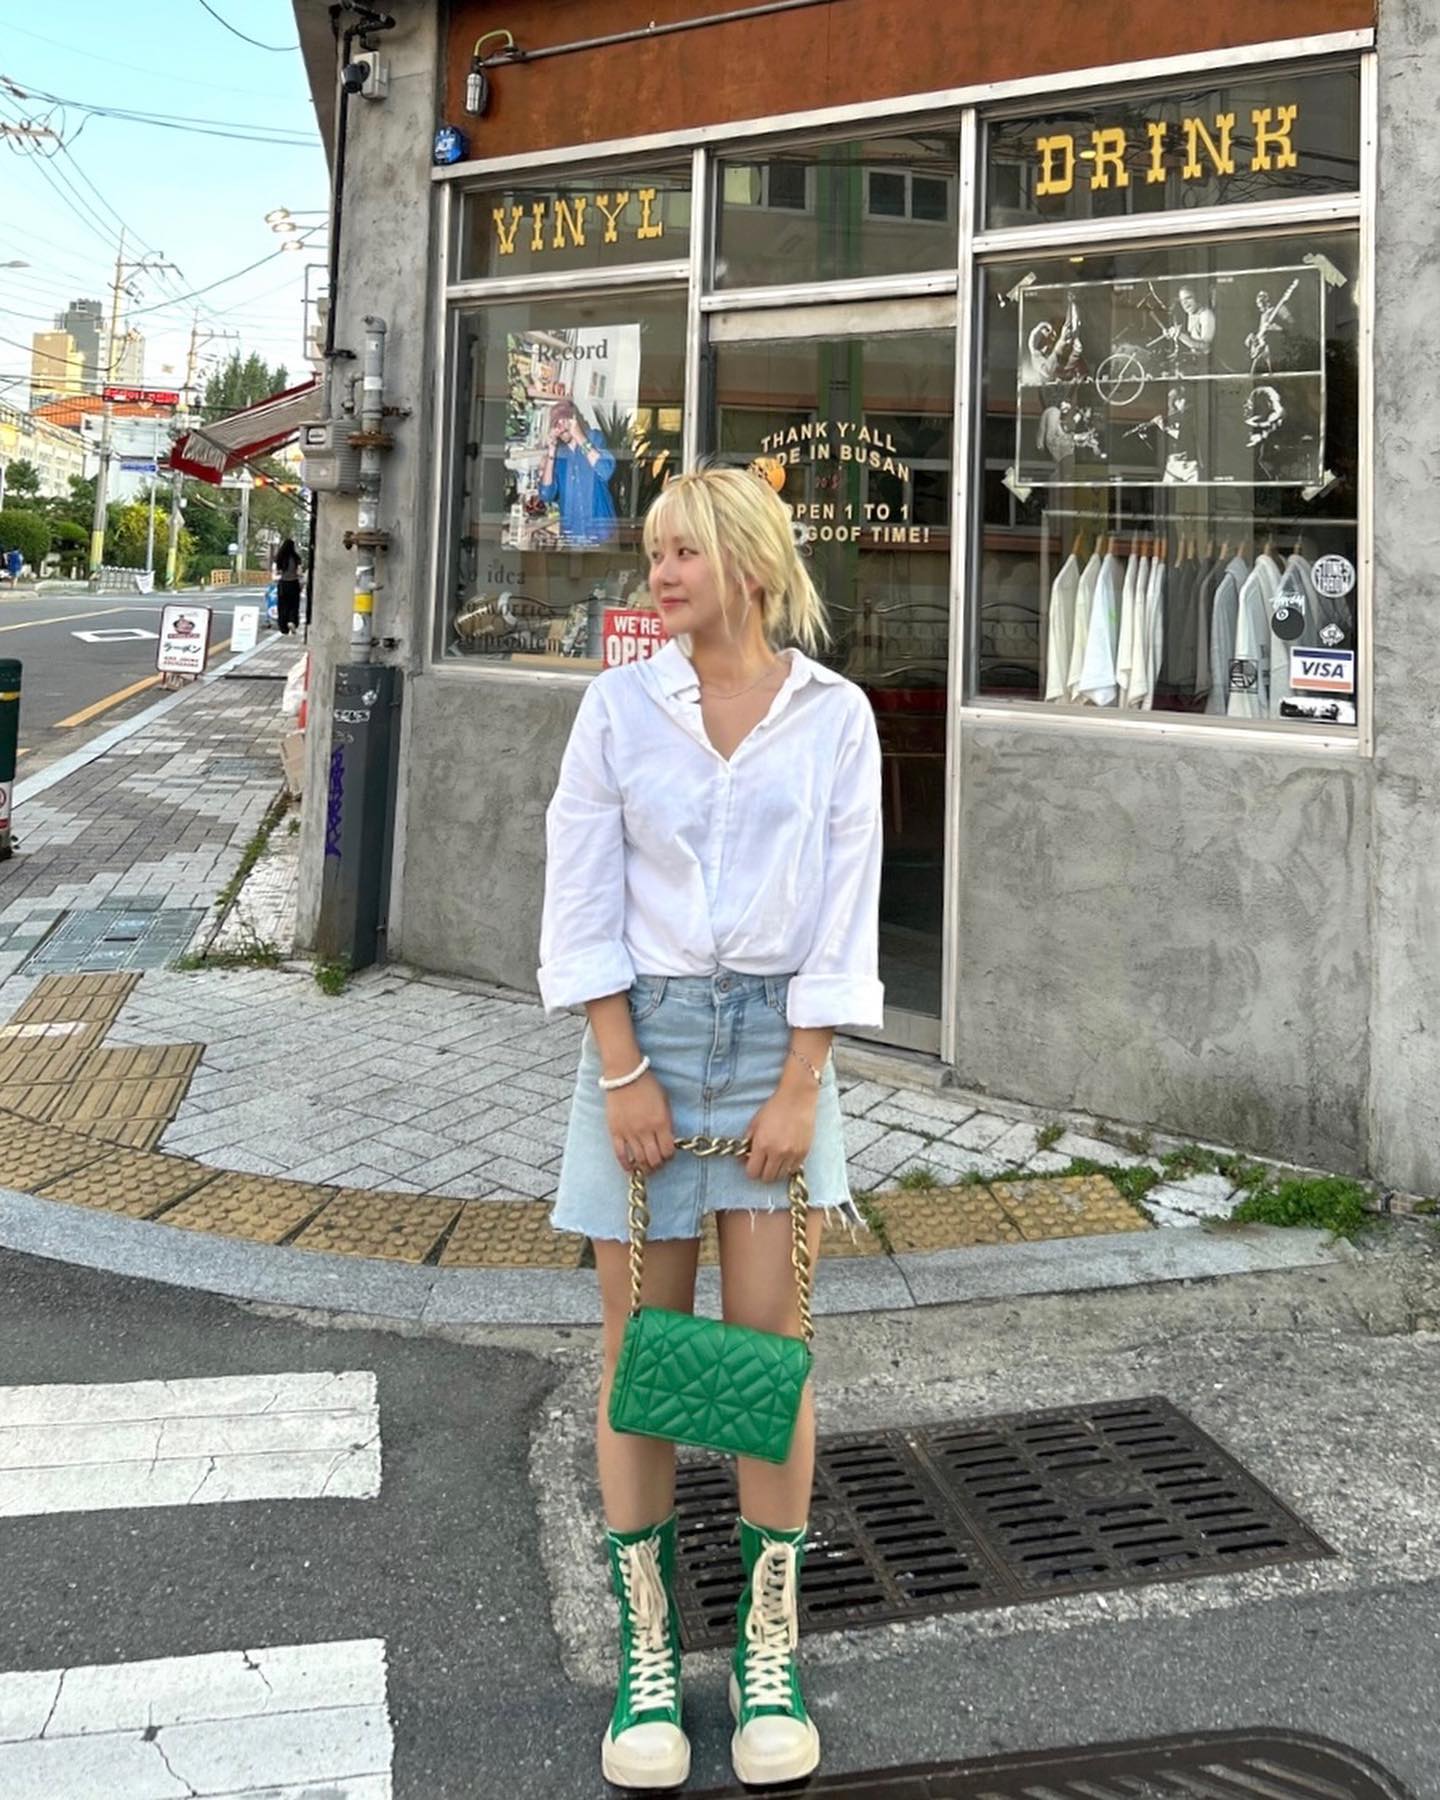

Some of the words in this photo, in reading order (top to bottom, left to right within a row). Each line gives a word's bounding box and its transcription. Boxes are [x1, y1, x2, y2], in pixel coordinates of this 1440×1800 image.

[1036, 105, 1297, 196] DRINK
[493, 188, 663, 254] VINYL
[537, 339, 608, 362] Record
[761, 422, 828, 453] THANK
[837, 422, 897, 453] Y'ALL
[810, 444, 830, 460] IN
[840, 445, 910, 482] BUSAN
[844, 503, 853, 520] 1
[864, 503, 890, 520] TO
[900, 504, 909, 520] 1
[806, 526, 862, 542] GOOF
[872, 527, 930, 543] TIME!
[487, 563, 526, 584] idea
[613, 615, 661, 636] WE'RE
[1301, 660, 1345, 679] VISA
